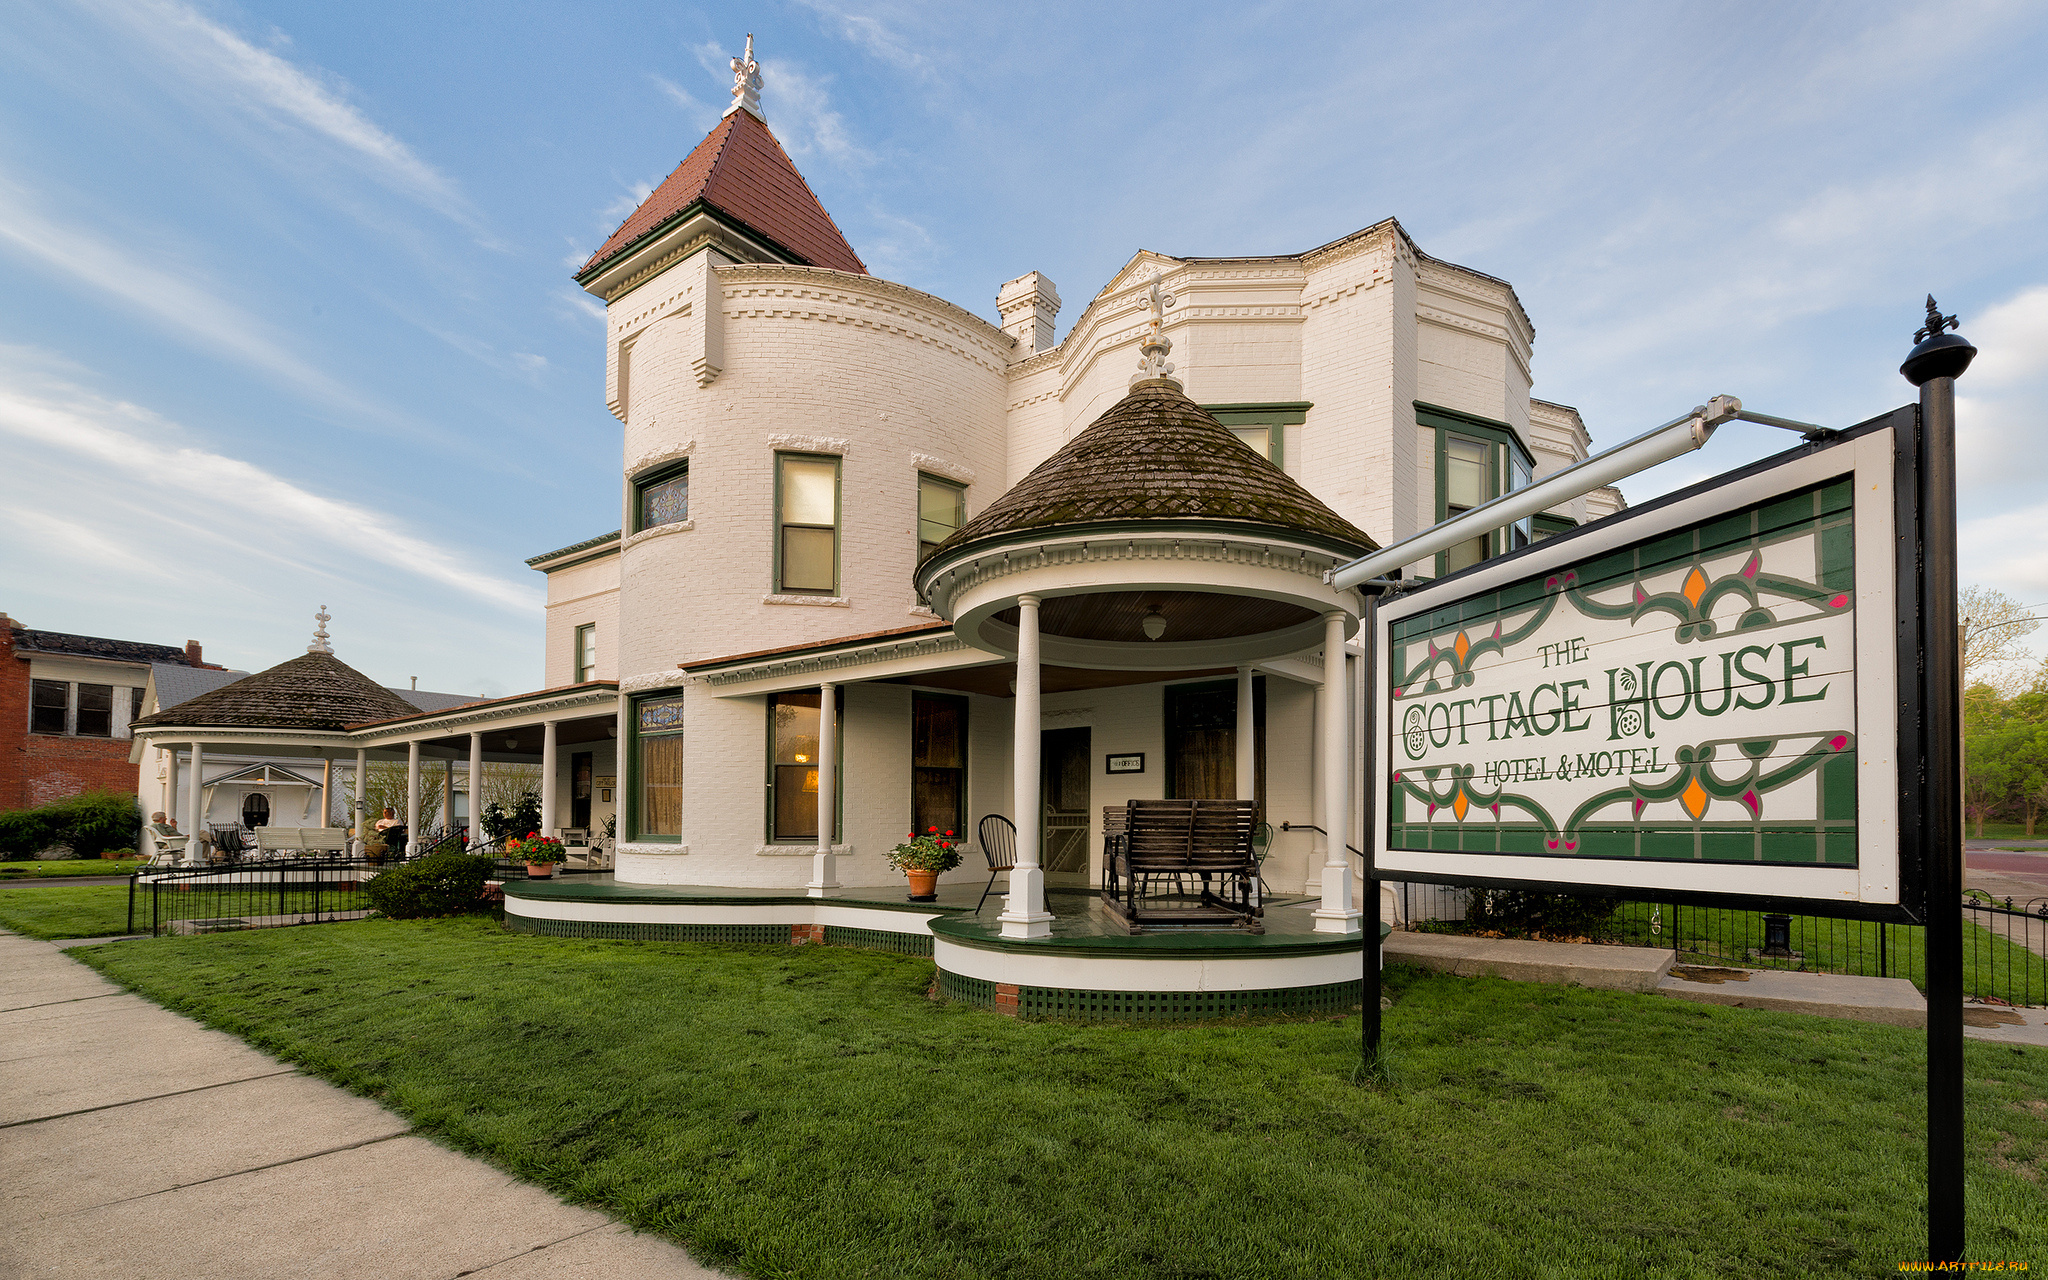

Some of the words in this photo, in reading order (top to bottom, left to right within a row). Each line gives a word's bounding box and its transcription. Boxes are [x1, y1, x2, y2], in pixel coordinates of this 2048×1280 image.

[1537, 636, 1590, 669] THE
[1402, 678, 1592, 761] COTTAGE
[1604, 636, 1831, 741] HOUSE
[1483, 756, 1553, 787] HOTEL
[1556, 754, 1573, 782] &
[1573, 746, 1669, 779] MOTEL
